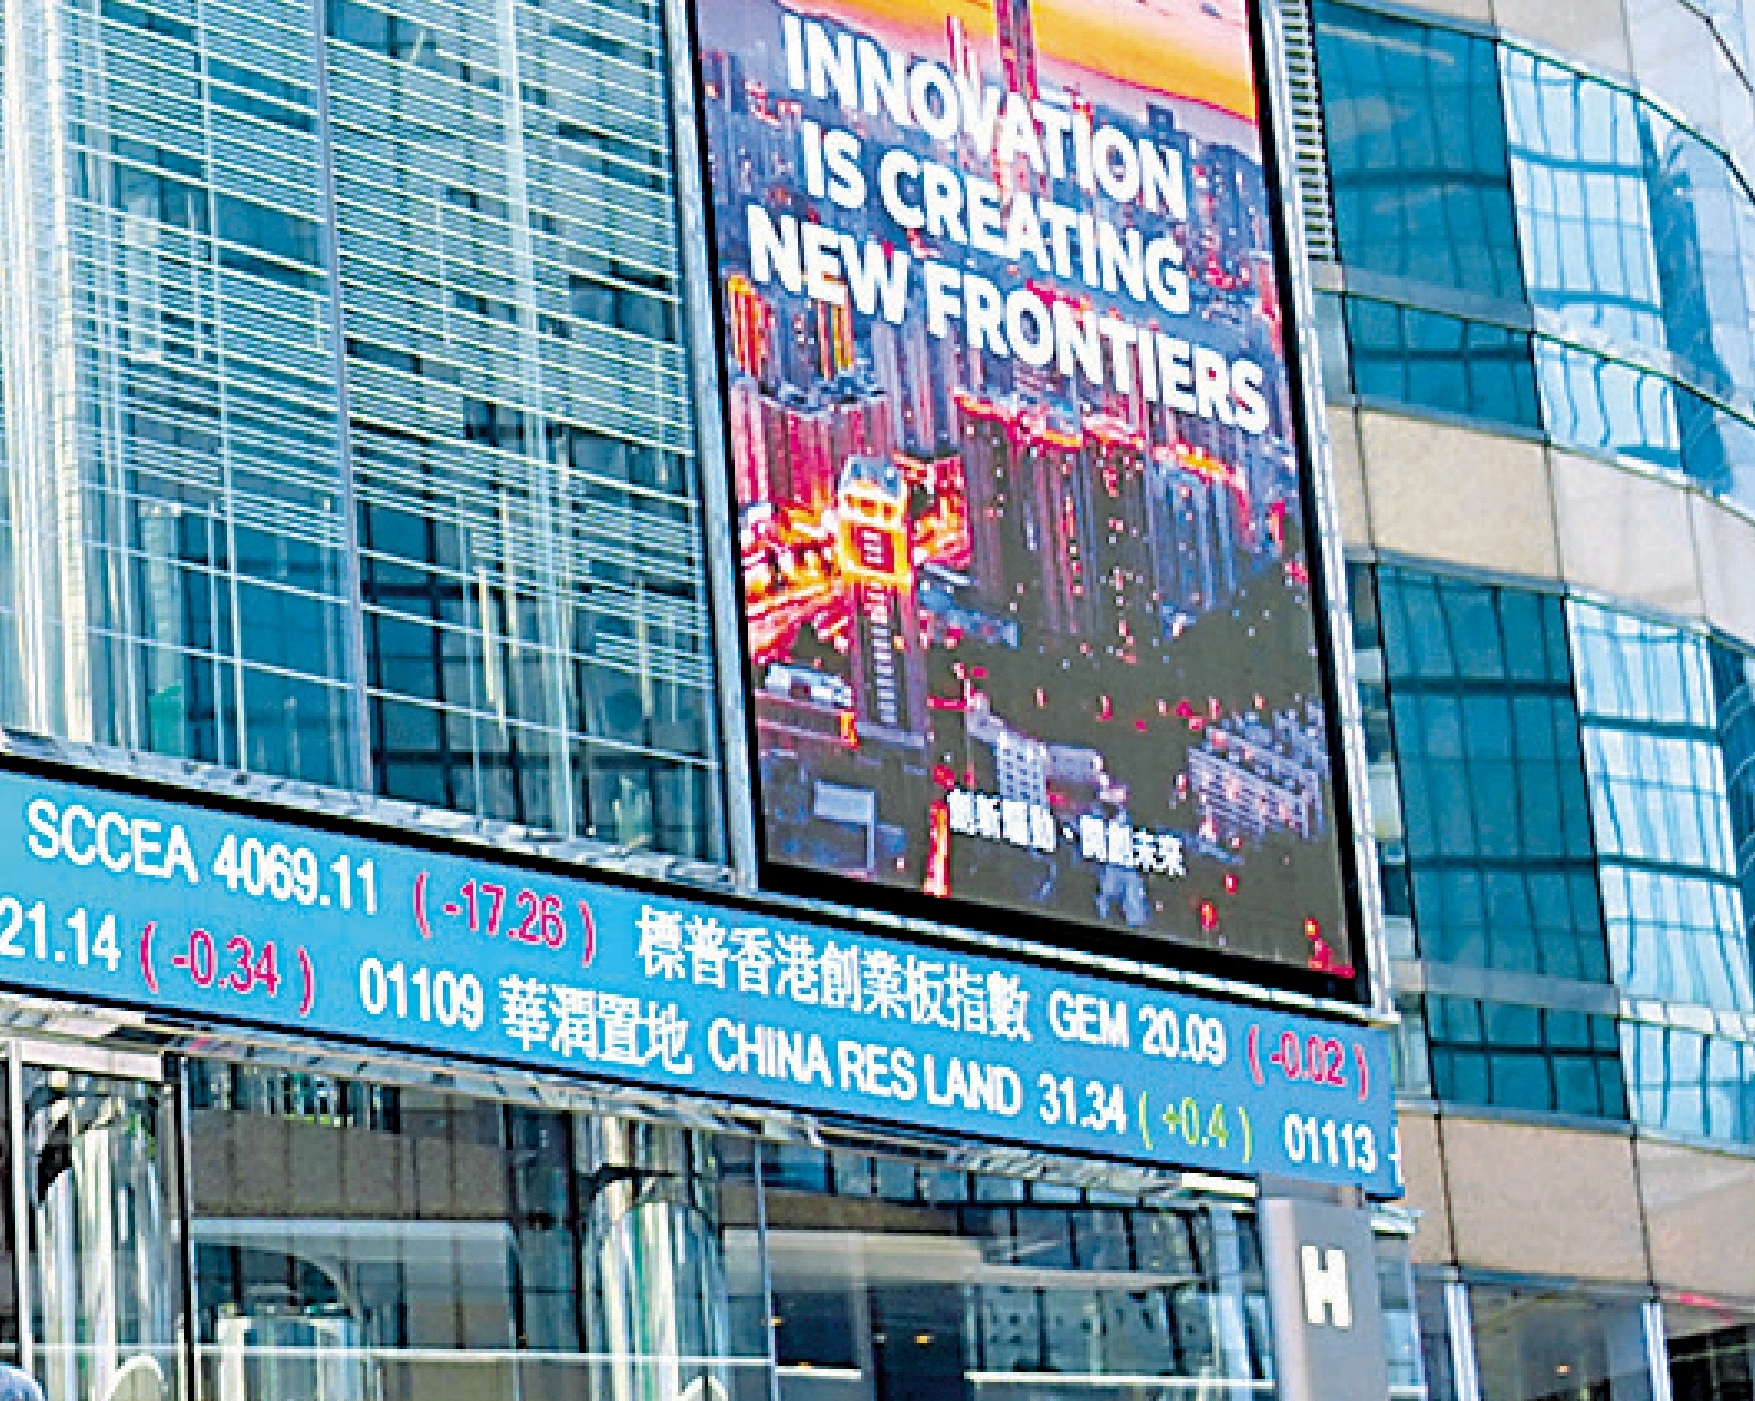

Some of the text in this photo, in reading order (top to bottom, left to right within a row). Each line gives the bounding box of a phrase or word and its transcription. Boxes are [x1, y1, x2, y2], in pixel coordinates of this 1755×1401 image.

[780, 11, 1188, 220] INNOVATION
[803, 125, 1190, 315] IS CREATING
[745, 204, 1269, 435] NEW FRONTIERS
[28, 799, 199, 886] SCCEA
[213, 833, 379, 916] 4069.11
[1049, 988, 1130, 1050] GEM
[1138, 1004, 1227, 1066] 20.09
[360, 958, 484, 1031] 01109
[498, 973, 695, 1074] 華潤置地
[707, 1017, 834, 1088] CHINA
[837, 1040, 918, 1101] RES
[923, 1054, 1023, 1116] LAND
[1040, 1073, 1128, 1135] 31.34
[1285, 1114, 1379, 1174] 01113
